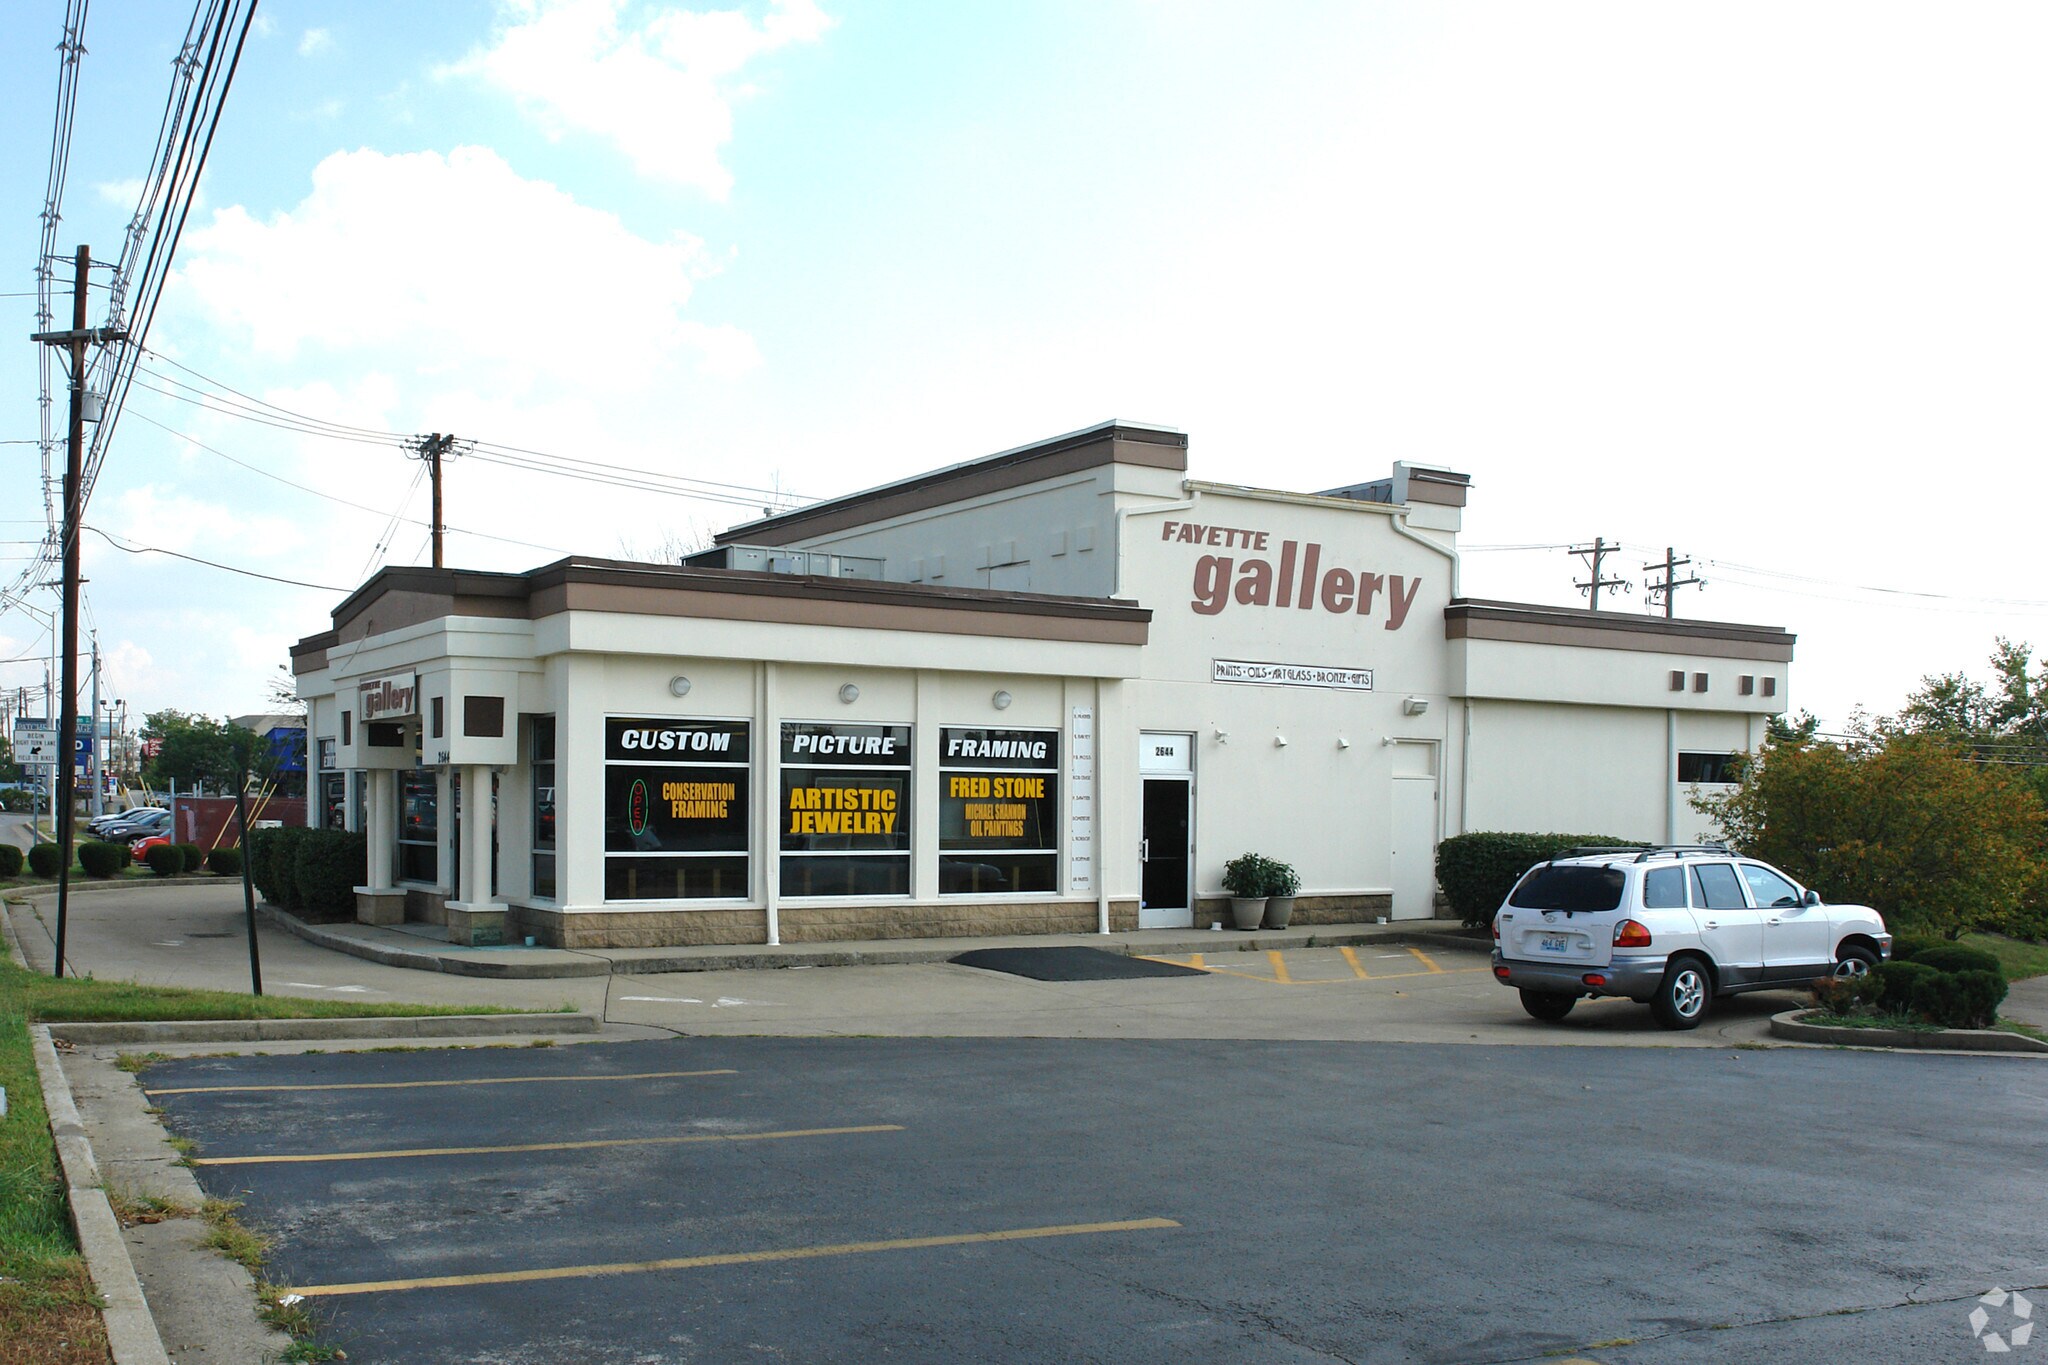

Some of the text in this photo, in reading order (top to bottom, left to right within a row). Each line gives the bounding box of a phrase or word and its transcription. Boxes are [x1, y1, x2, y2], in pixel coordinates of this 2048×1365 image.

[1162, 521, 1270, 551] FAYETTE
[1191, 540, 1422, 631] gallery
[1216, 664, 1370, 686] PRINTS OILS ART GLASS BRONZE GIFTS
[366, 681, 415, 719] gallery
[621, 729, 1047, 759] CUSTOM PICTURE FRAMING
[1155, 746, 1174, 757] 2644
[438, 751, 450, 764] 2644
[662, 782, 736, 801] CONSERVATION
[950, 777, 1045, 799] FRED STONE
[671, 800, 728, 819] FRAMING
[789, 788, 897, 812] ARTISTIC
[965, 803, 1027, 820] MICHAEL SHANNON
[789, 812, 897, 835] JEWELRY
[970, 820, 1024, 837] OIL PAINTINGS
